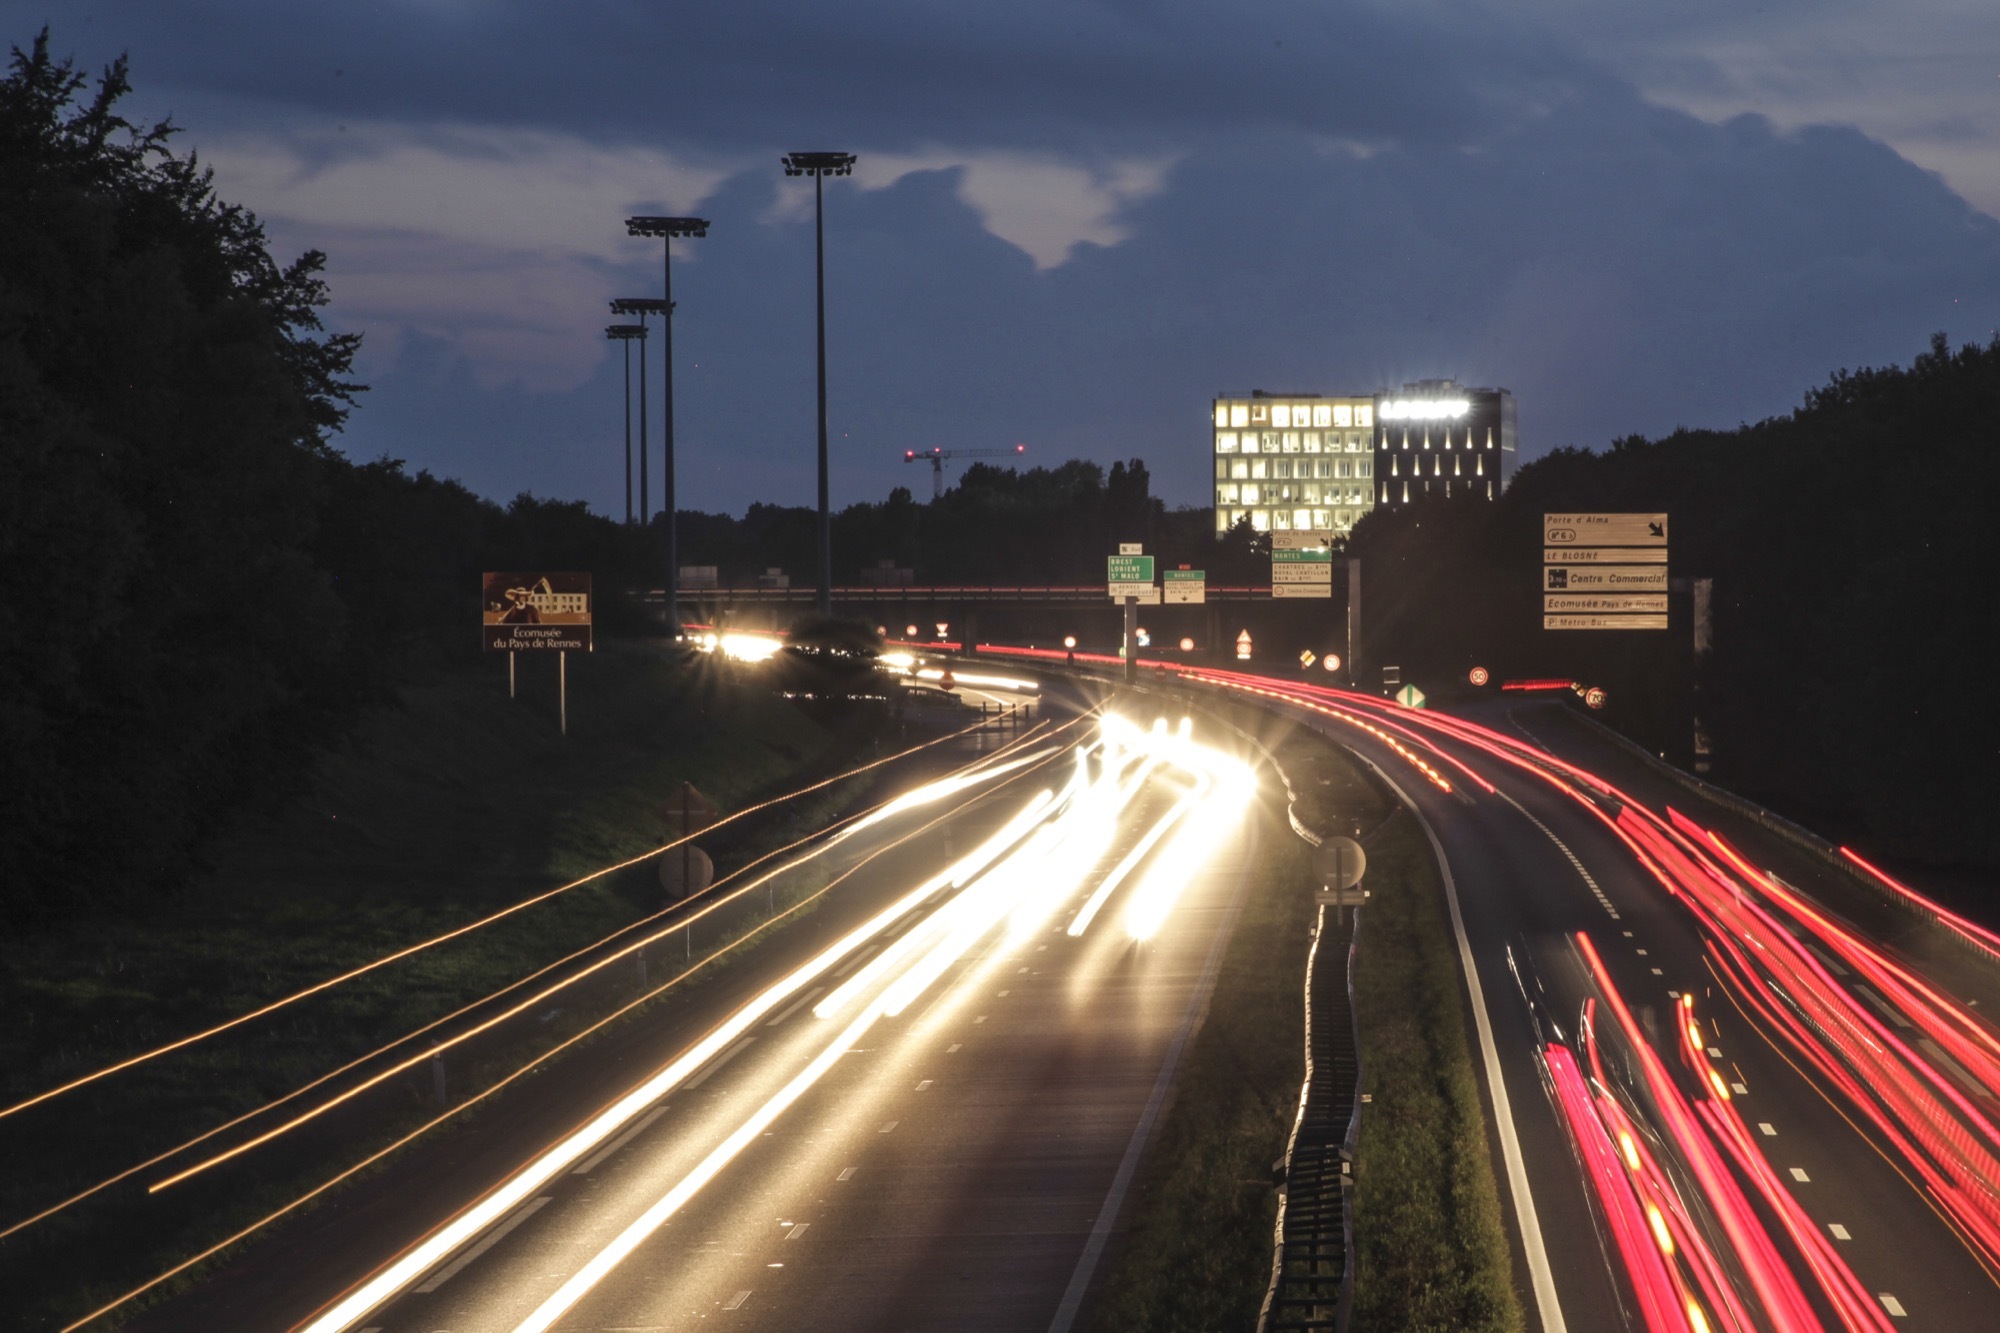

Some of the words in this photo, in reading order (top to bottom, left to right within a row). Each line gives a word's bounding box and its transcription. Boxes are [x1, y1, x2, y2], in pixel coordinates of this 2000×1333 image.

[1547, 516, 1572, 524] Porte
[1547, 552, 1557, 560] LE
[1562, 552, 1599, 560] BLOSNE
[1570, 574, 1603, 583] Centre
[1608, 573, 1665, 583] Commercial
[1601, 600, 1620, 608] Pays
[1622, 600, 1632, 608] de
[1636, 600, 1664, 608] Rennes
[514, 626, 562, 638] Écomusée
[494, 638, 506, 648] du
[509, 638, 530, 651] Pays
[532, 638, 545, 648] de
[546, 638, 582, 648] Rennes
[1474, 672, 1484, 680] 50
[1592, 693, 1602, 702] 70
